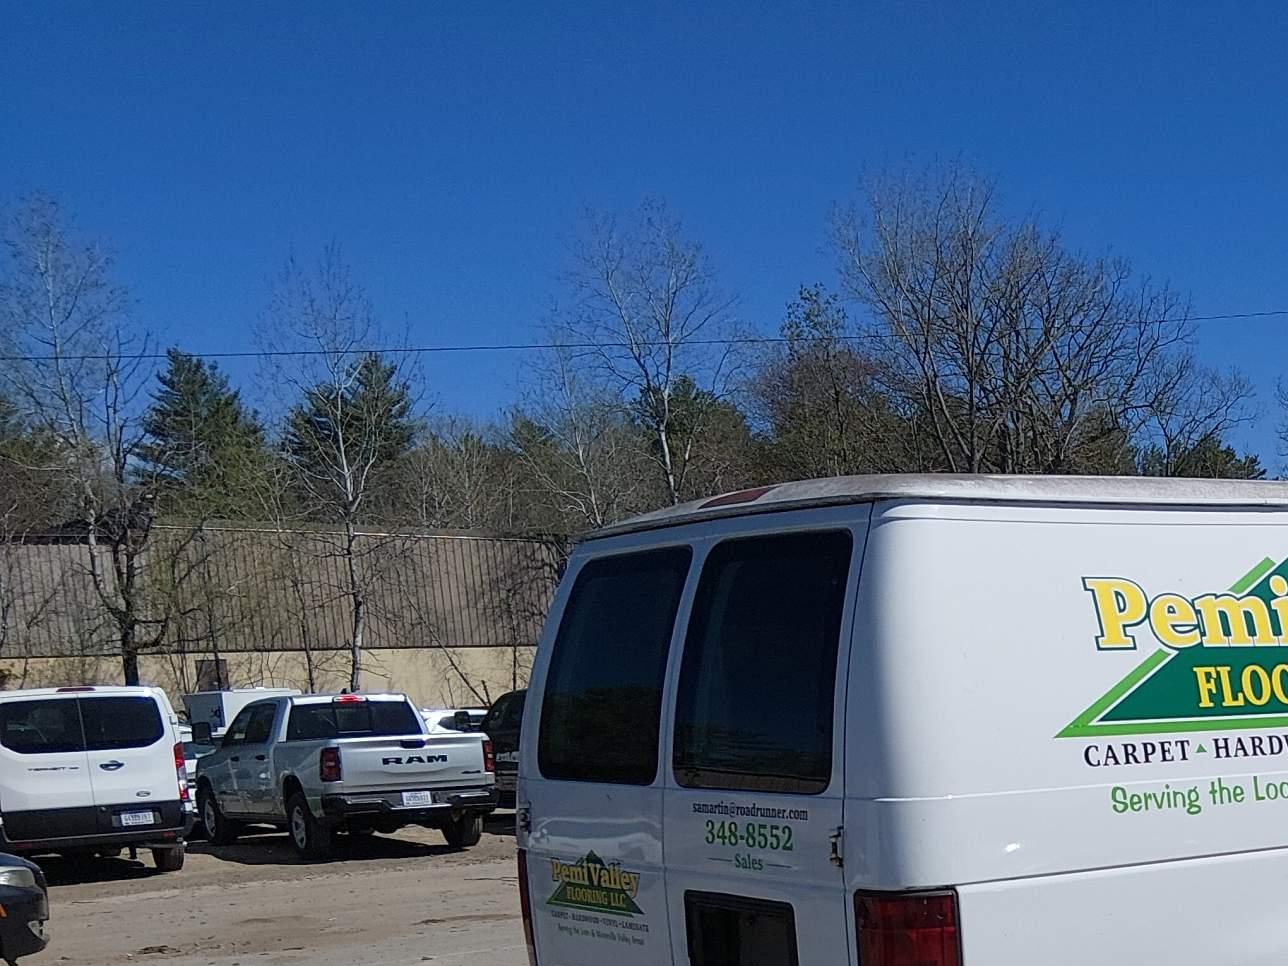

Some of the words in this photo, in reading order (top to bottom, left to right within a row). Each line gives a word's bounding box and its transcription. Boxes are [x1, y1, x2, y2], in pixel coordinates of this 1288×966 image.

[382, 755, 448, 765] RAM
[1084, 740, 1190, 767] CARPET
[1111, 784, 1202, 815] Serving
[1209, 777, 1245, 805] the
[692, 800, 808, 821] samartin@roadrunner.com
[705, 820, 793, 851] 348-8552
[734, 853, 764, 870] Sales
